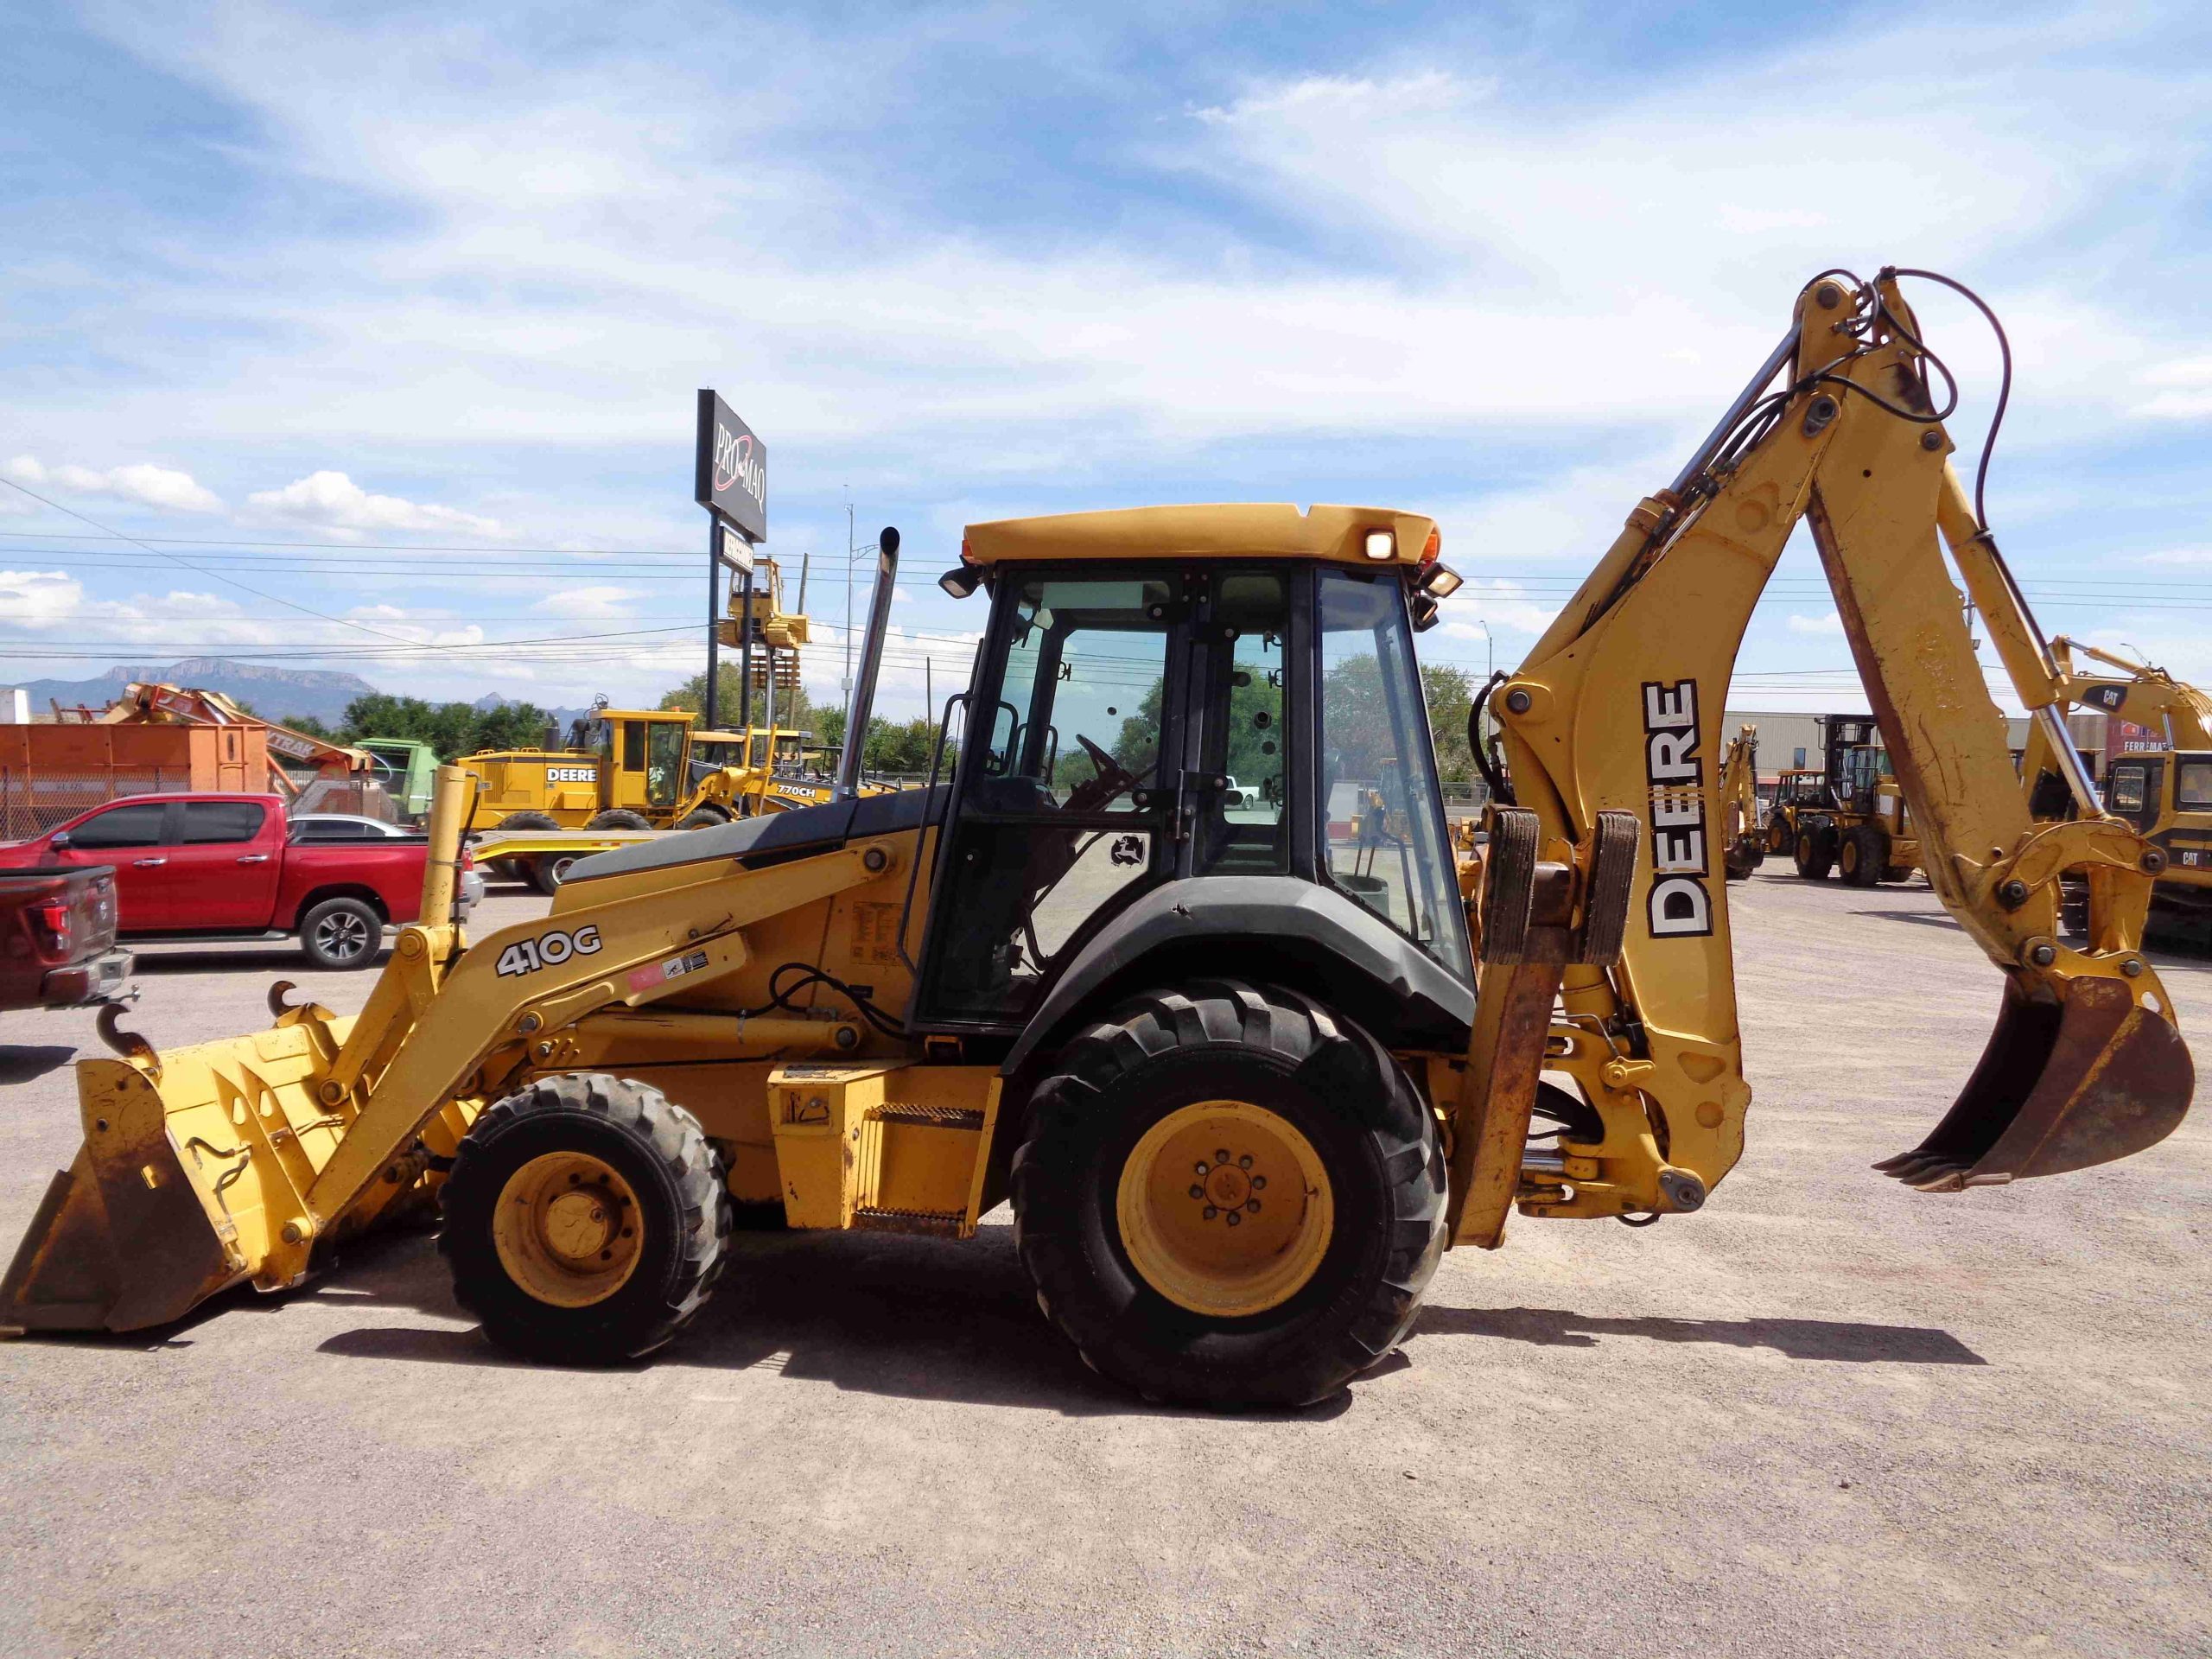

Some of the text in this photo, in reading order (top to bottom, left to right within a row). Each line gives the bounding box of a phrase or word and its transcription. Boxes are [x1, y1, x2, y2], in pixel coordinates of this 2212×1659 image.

[2103, 690, 2118, 706] CAT
[547, 768, 596, 782] DEERE
[778, 785, 816, 798] 770CH
[1645, 682, 1709, 934] DEERE
[2183, 851, 2198, 866] CAT
[496, 925, 602, 976] 410G
